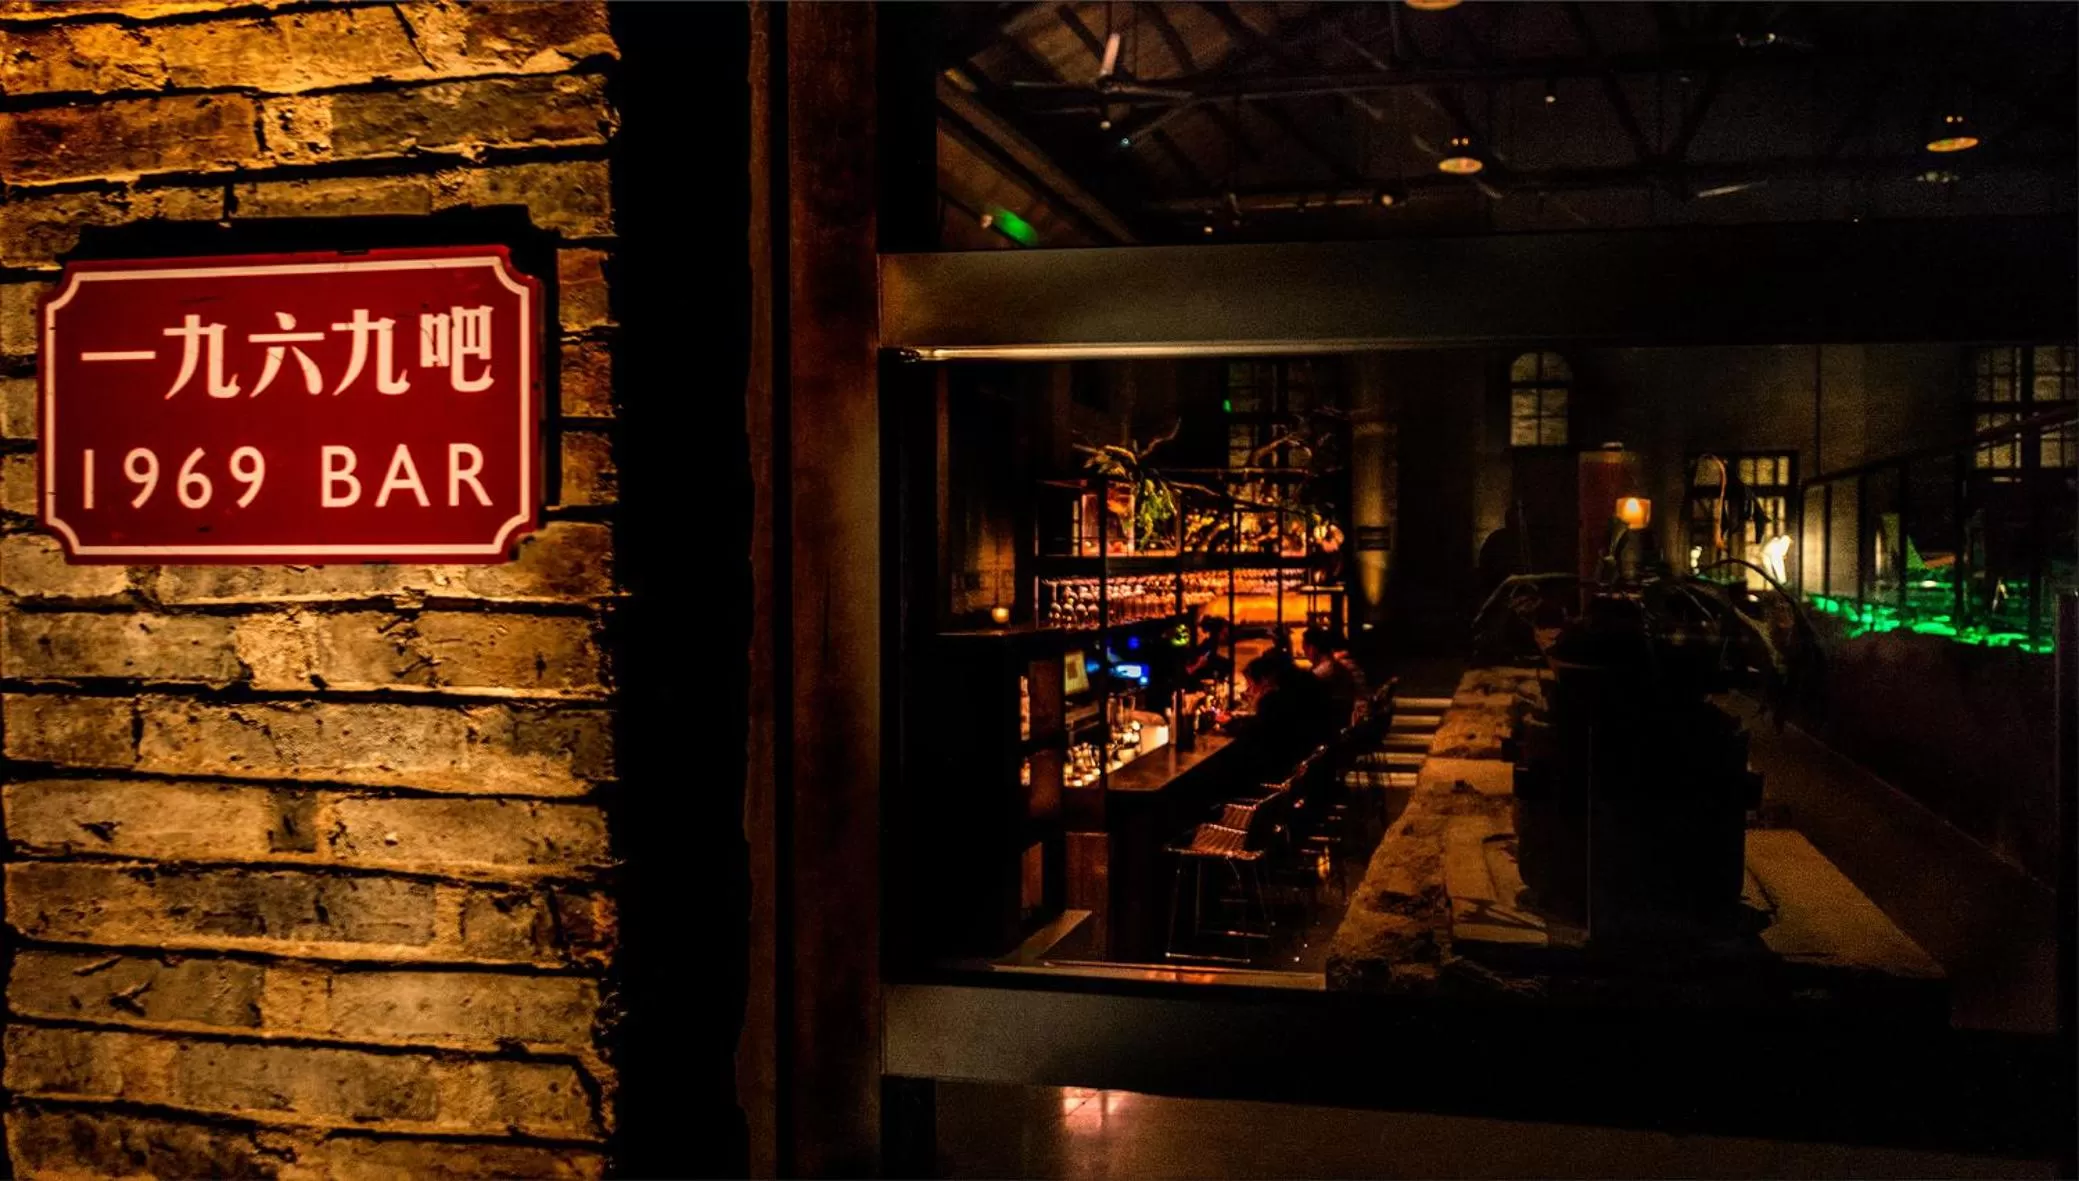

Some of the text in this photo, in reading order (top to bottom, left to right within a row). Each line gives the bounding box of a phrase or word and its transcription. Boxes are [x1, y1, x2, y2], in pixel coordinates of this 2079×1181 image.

[81, 305, 495, 400] 一九六九吧
[83, 443, 493, 509] 1969 BAR
